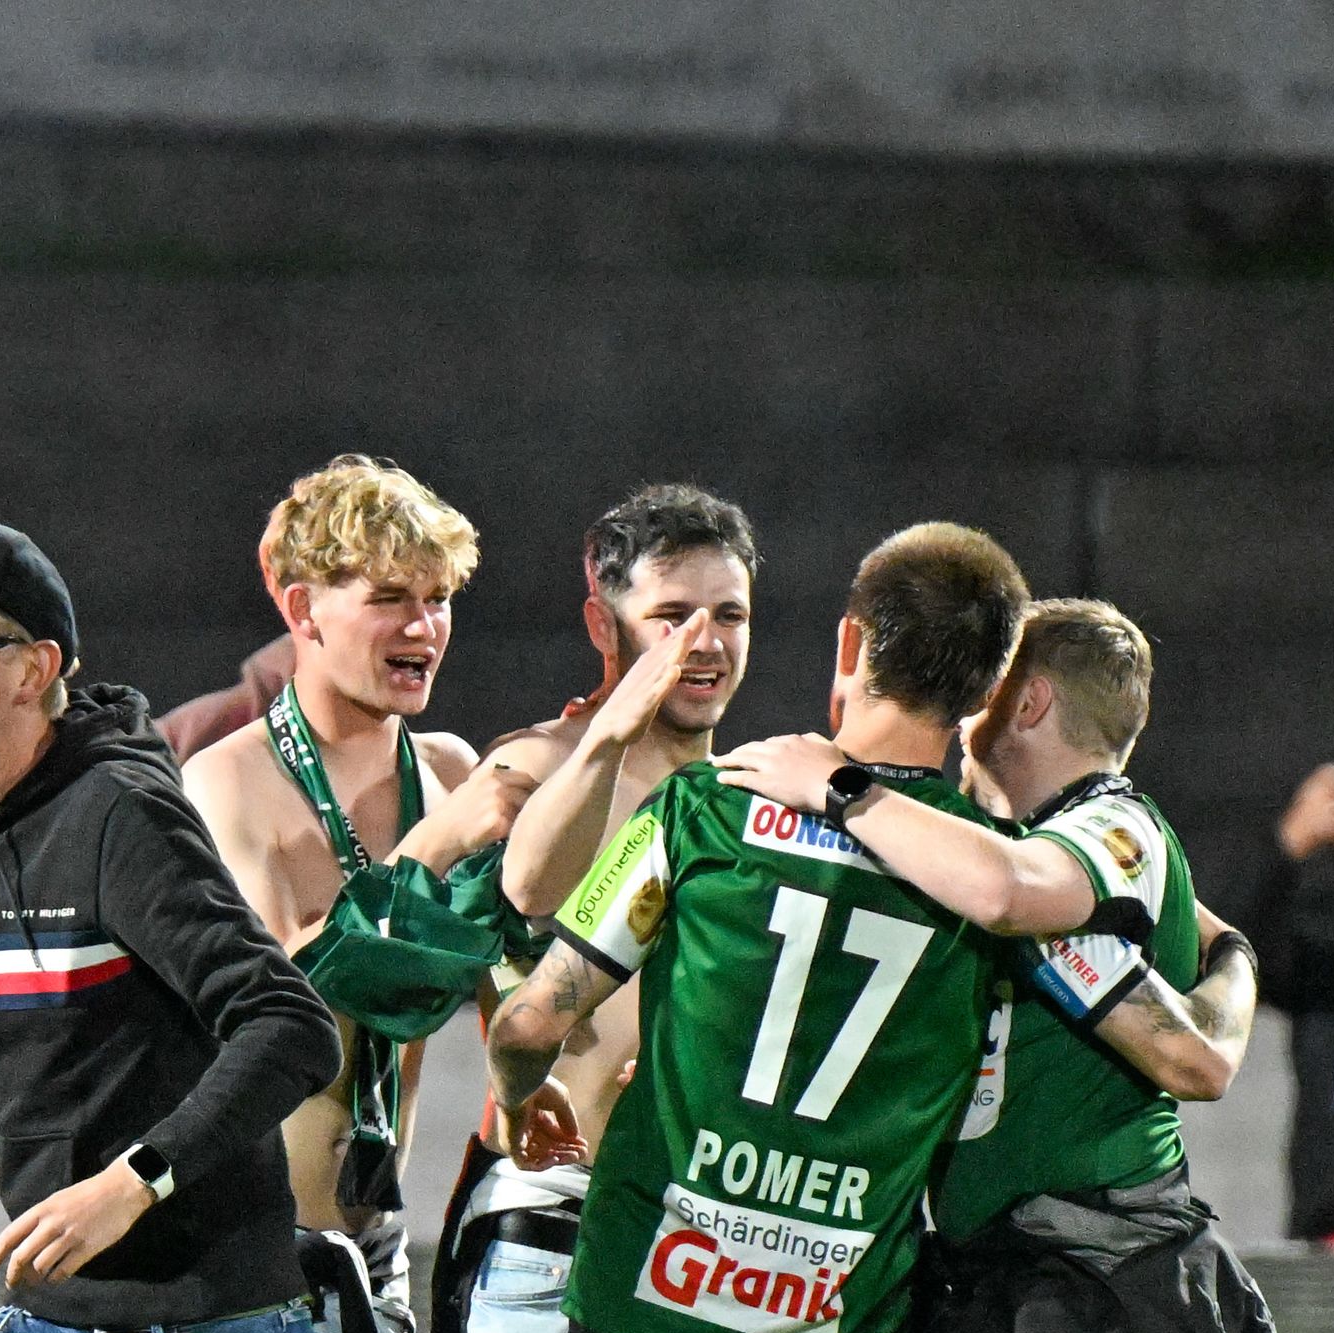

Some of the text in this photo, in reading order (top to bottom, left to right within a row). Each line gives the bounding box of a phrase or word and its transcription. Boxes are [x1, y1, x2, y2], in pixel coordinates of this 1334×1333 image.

[575, 818, 656, 927] gourmetfein
[742, 885, 936, 1121] 17
[687, 1128, 870, 1220] POMER
[650, 1229, 850, 1322] Granit
[677, 1196, 864, 1266] Schärdinger
